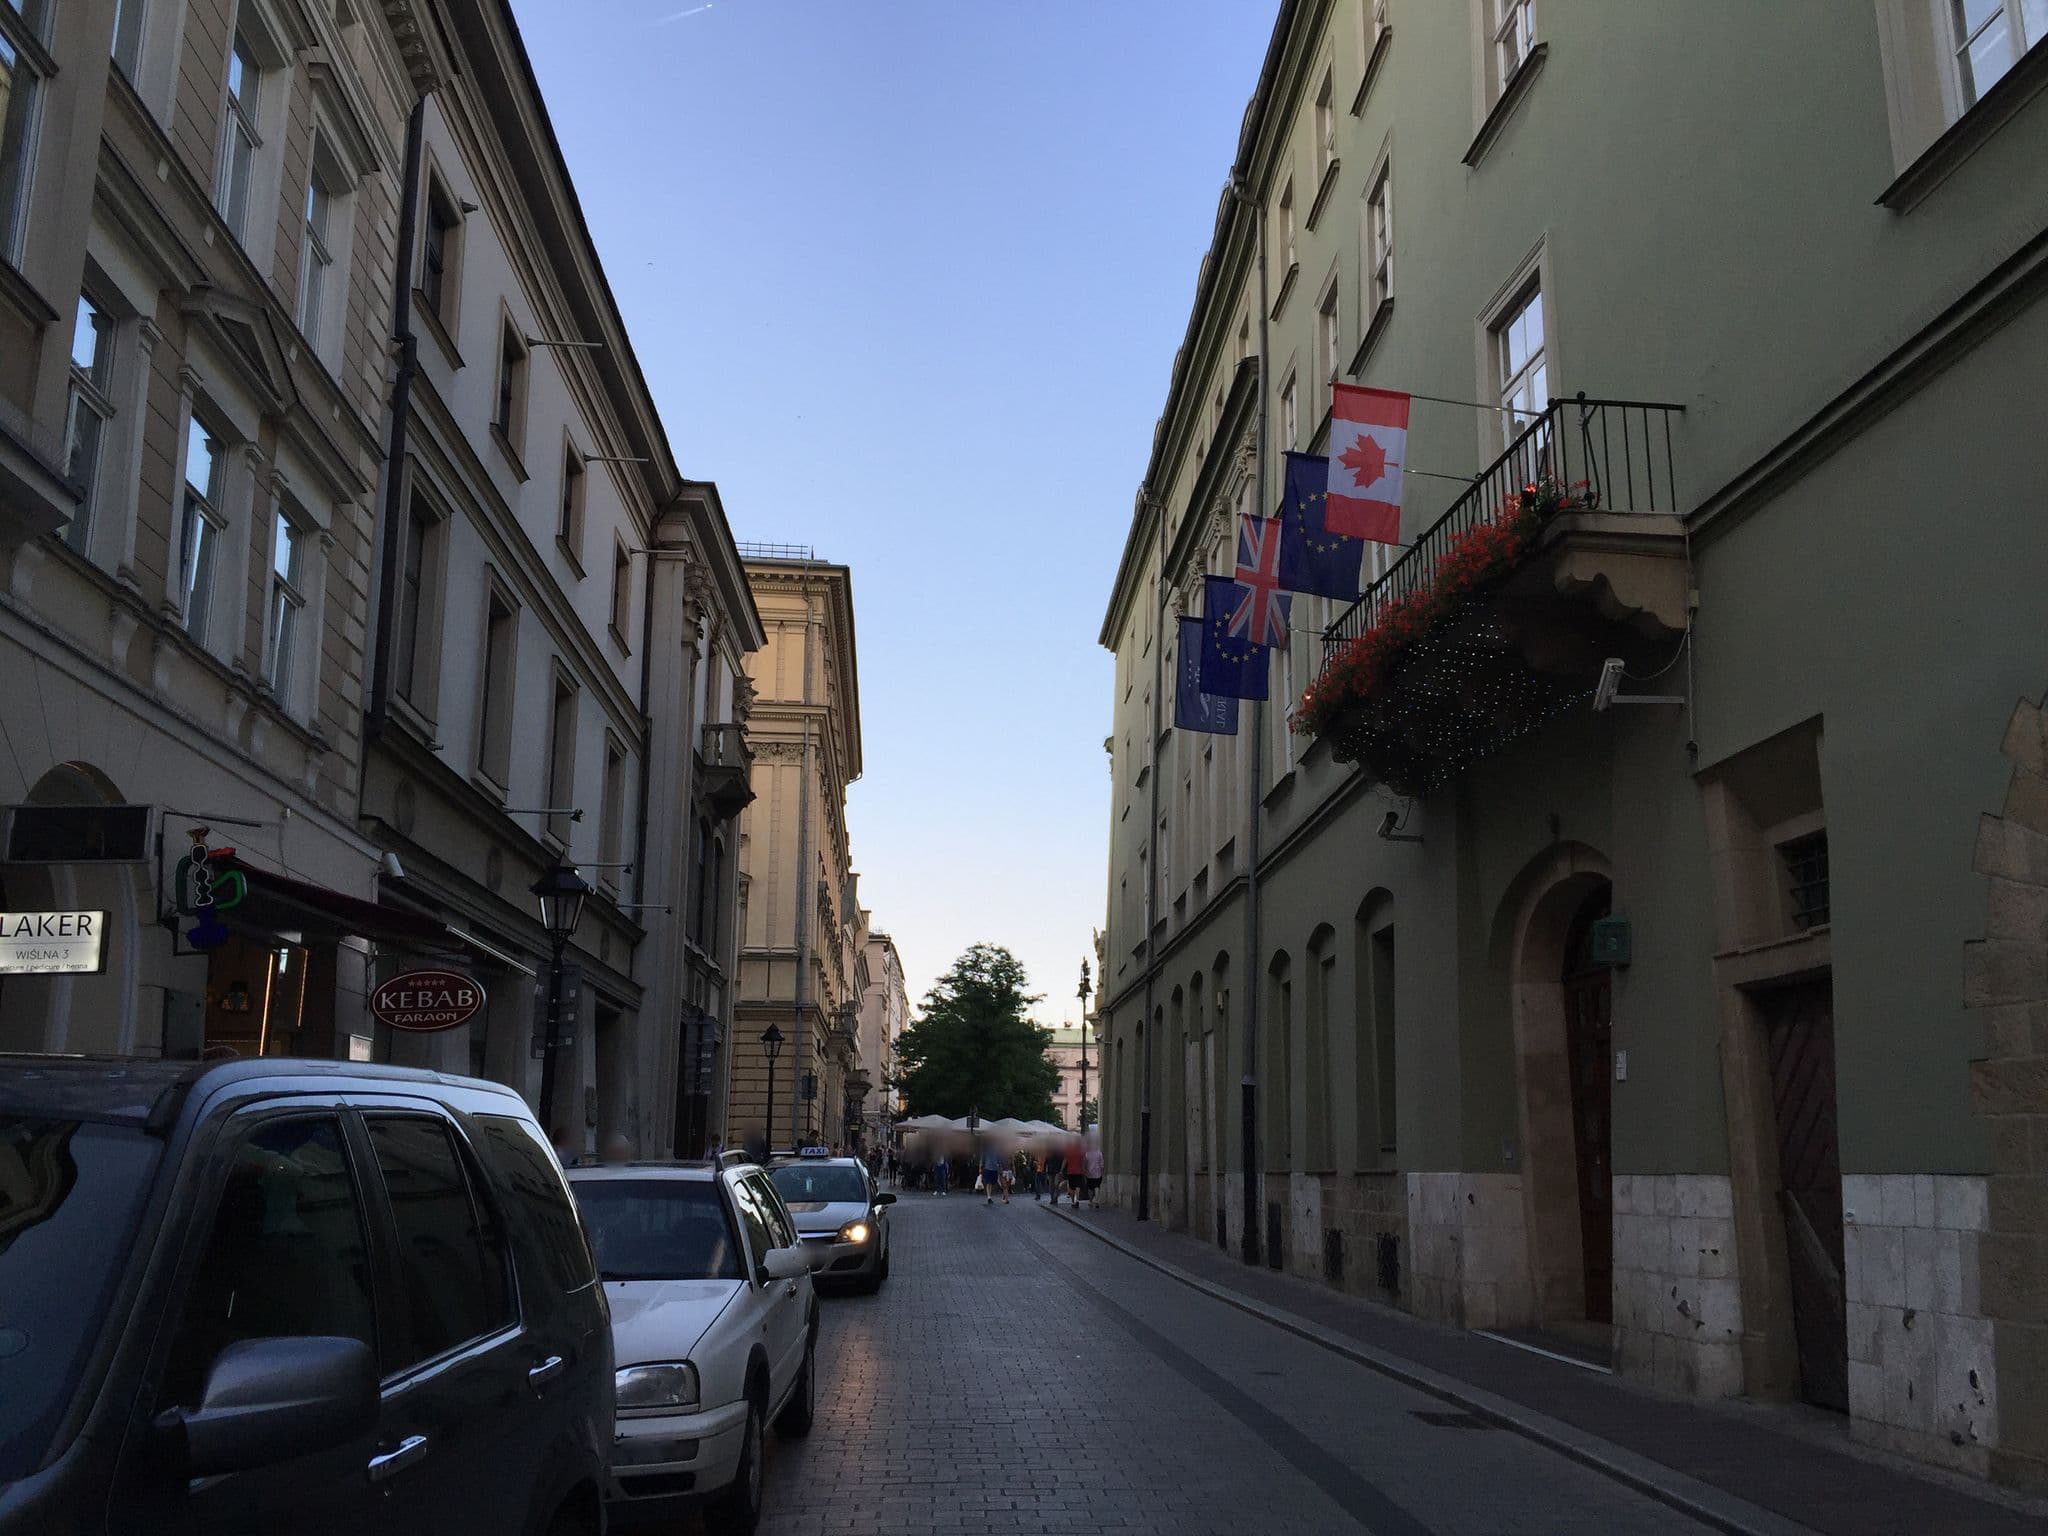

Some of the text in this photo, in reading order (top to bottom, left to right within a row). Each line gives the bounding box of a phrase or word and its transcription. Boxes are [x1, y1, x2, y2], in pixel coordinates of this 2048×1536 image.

[16, 948, 69, 960] WIŚLNA 3
[381, 989, 473, 1009] KEBAB
[394, 1012, 458, 1023] FARAON
